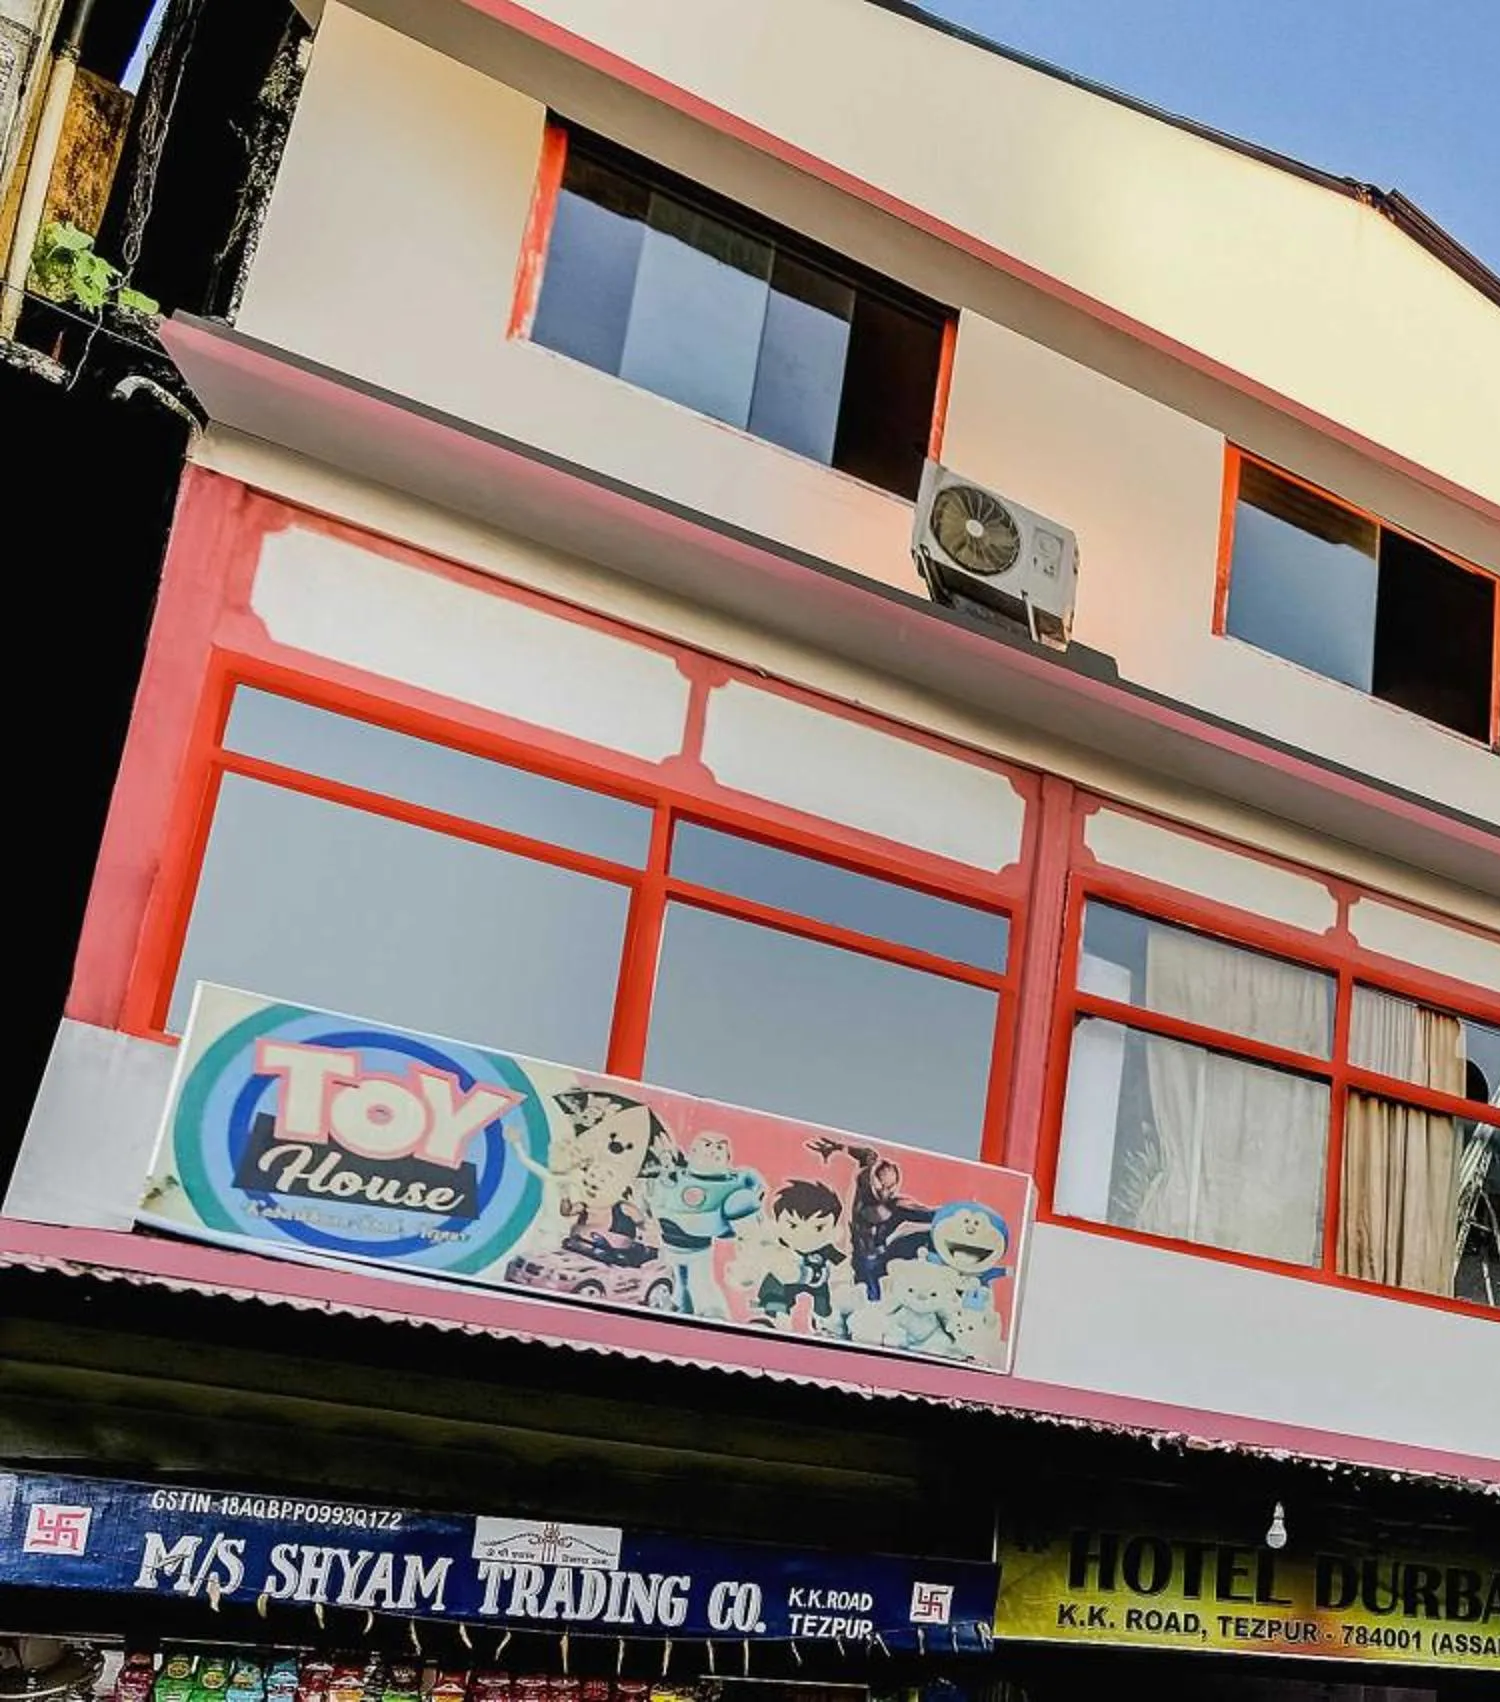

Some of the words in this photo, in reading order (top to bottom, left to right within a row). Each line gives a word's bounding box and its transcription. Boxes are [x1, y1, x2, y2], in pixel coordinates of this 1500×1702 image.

[254, 1038, 527, 1169] TOY
[257, 1143, 466, 1212] House
[133, 1531, 246, 1597] M/S
[264, 1542, 453, 1613] SHYAM
[478, 1561, 691, 1627] TRADING
[707, 1581, 767, 1634] CO.
[1067, 1531, 1293, 1607] HOTEL
[1057, 1602, 1115, 1630] K.K.
[1125, 1609, 1208, 1640] ROAD,
[1217, 1615, 1320, 1644] TEZPUR
[1342, 1625, 1422, 1651] 784001
